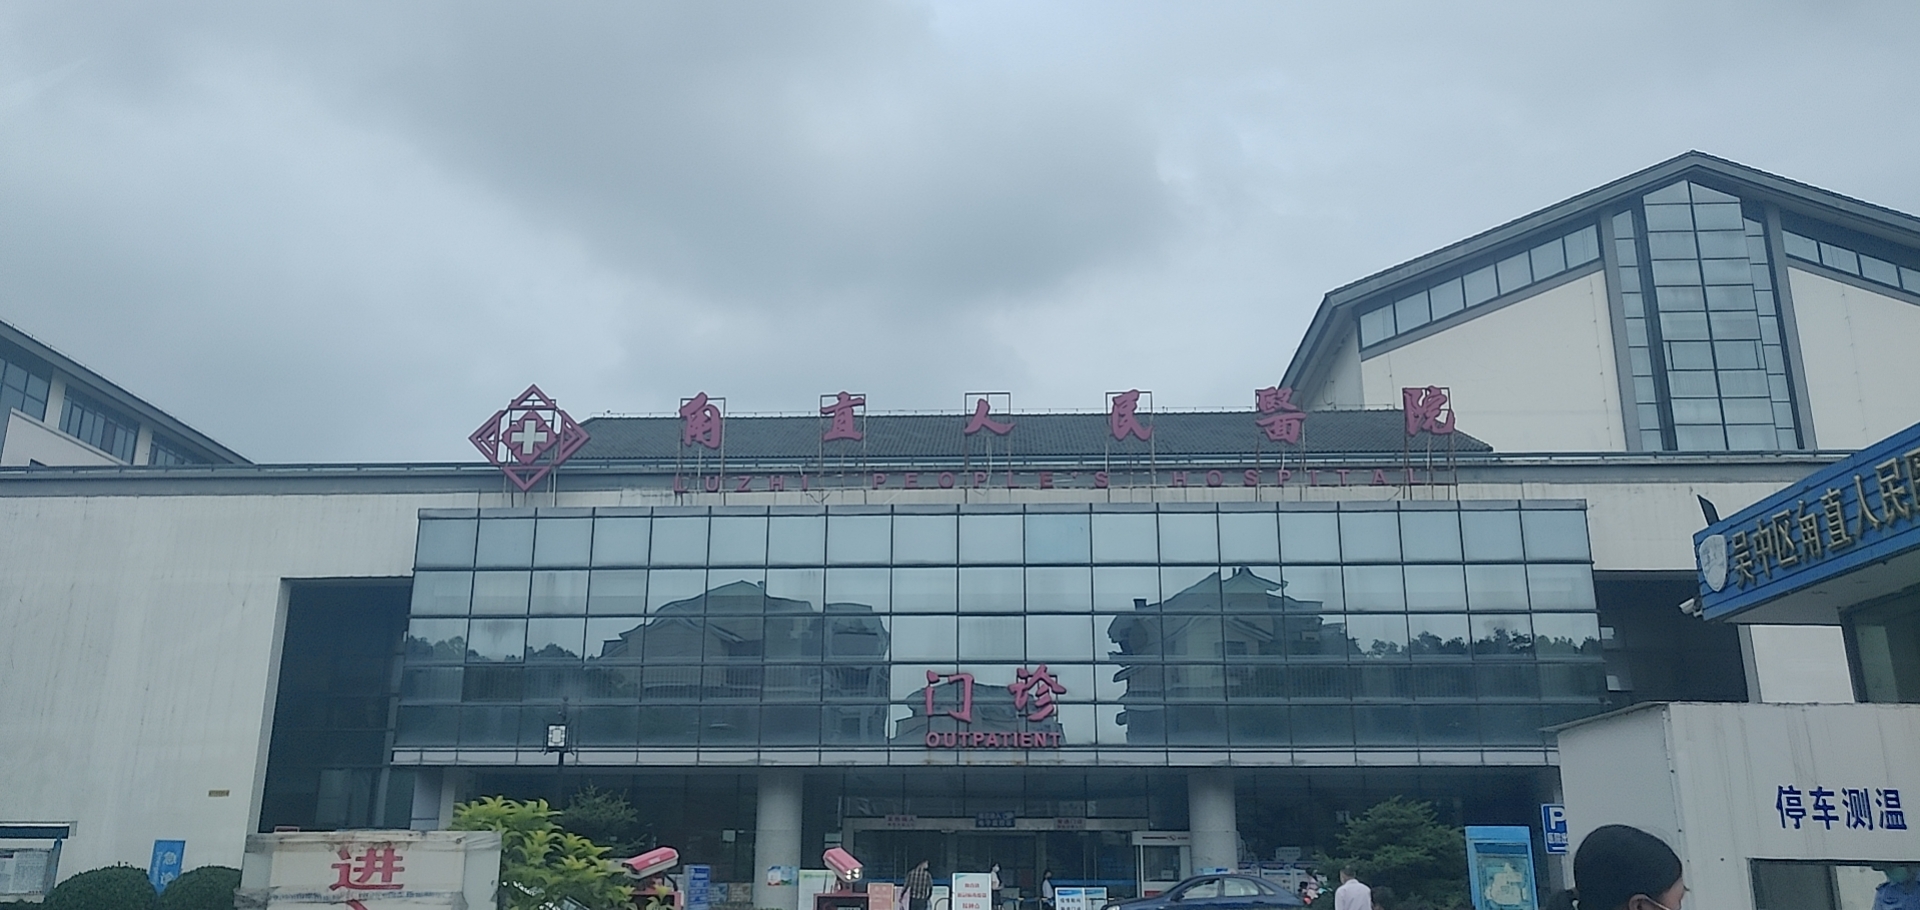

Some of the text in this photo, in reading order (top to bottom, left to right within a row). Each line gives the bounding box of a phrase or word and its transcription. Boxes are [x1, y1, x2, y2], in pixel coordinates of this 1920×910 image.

[673, 467, 1432, 494] LUZHI PEOPLE'S HOSPITAL
[926, 664, 1067, 722] 门诊
[926, 731, 1060, 748] OUTPATIENT
[1776, 784, 1908, 832] 停车测温
[329, 843, 405, 891] 进
